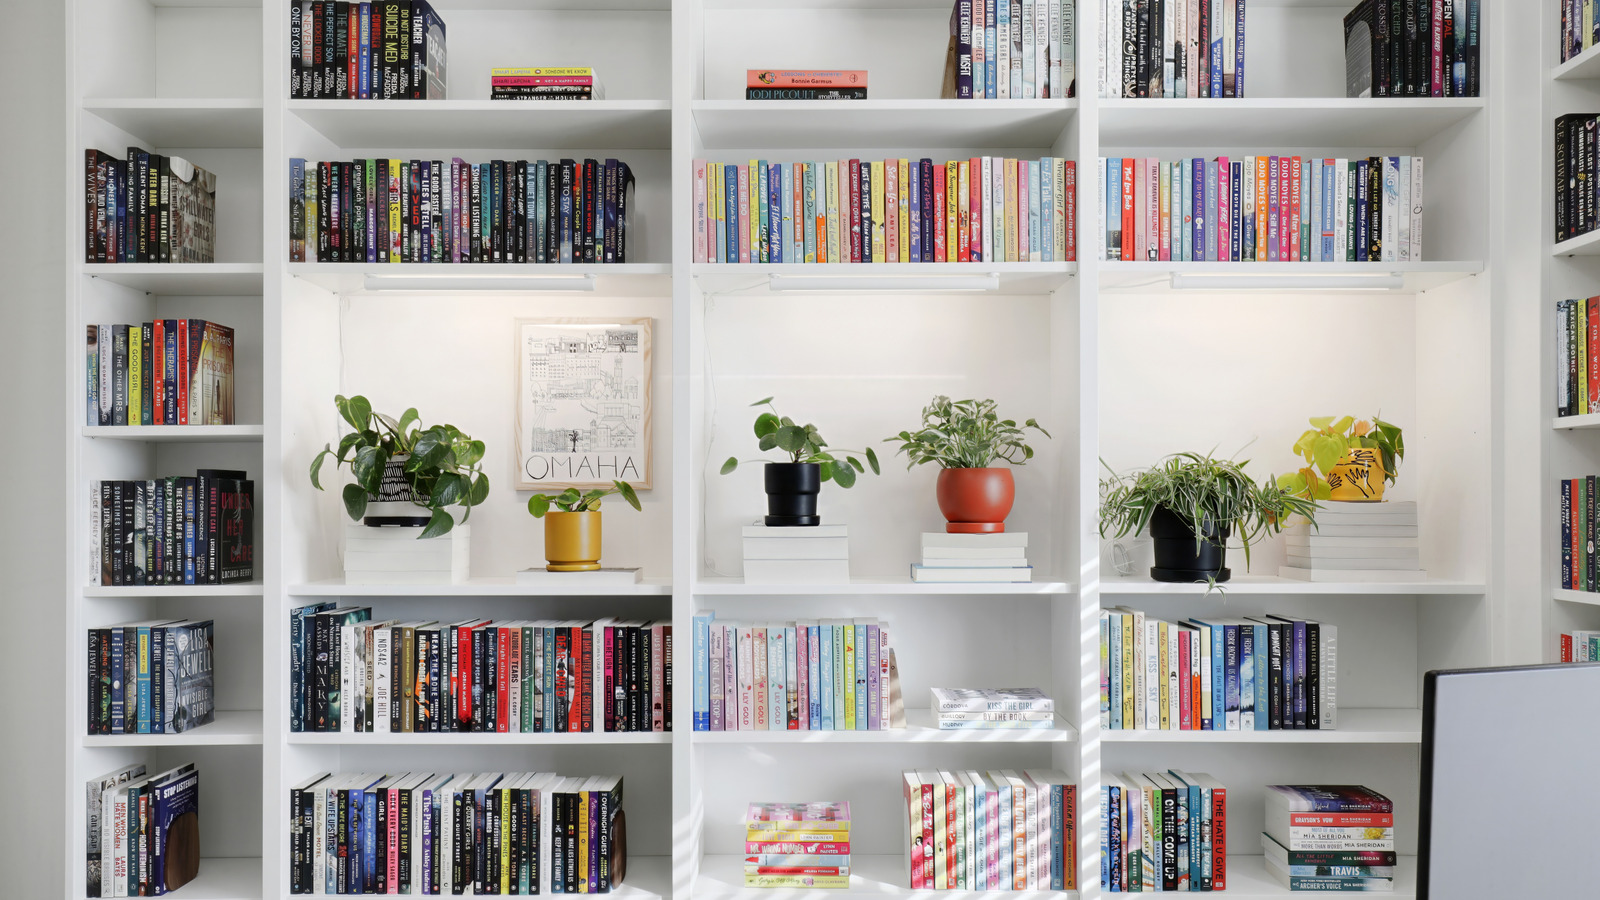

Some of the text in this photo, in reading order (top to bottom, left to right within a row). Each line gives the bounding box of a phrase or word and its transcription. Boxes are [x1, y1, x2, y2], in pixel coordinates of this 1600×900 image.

[401, 9, 408, 18] DO
[960, 2, 970, 15] ELLE
[292, 28, 300, 38] BY
[385, 5, 398, 62] SUICIDE MED
[413, 16, 423, 44] TEACHER
[960, 17, 970, 44] KENNEDY
[750, 90, 815, 99] JODI PICOULT
[1557, 121, 1564, 131] V.
[1557, 132, 1564, 142] E.
[108, 167, 114, 176] AN
[563, 185, 569, 194] TO
[741, 192, 747, 202] ME
[741, 204, 747, 216] DO
[526, 455, 639, 479] OMAHA
[1271, 630, 1280, 670] MIDNIGHT DUET
[556, 636, 566, 696] DEAR CHILD
[1327, 645, 1335, 682] LITTLE
[378, 639, 386, 718] NOS4A2 JOE HILL
[1327, 685, 1335, 708] LIFE
[1165, 800, 1174, 879] ON THE COME UP
[750, 844, 804, 854] MR. WRONG NUMBER
[1331, 867, 1359, 875] TRAVIS
